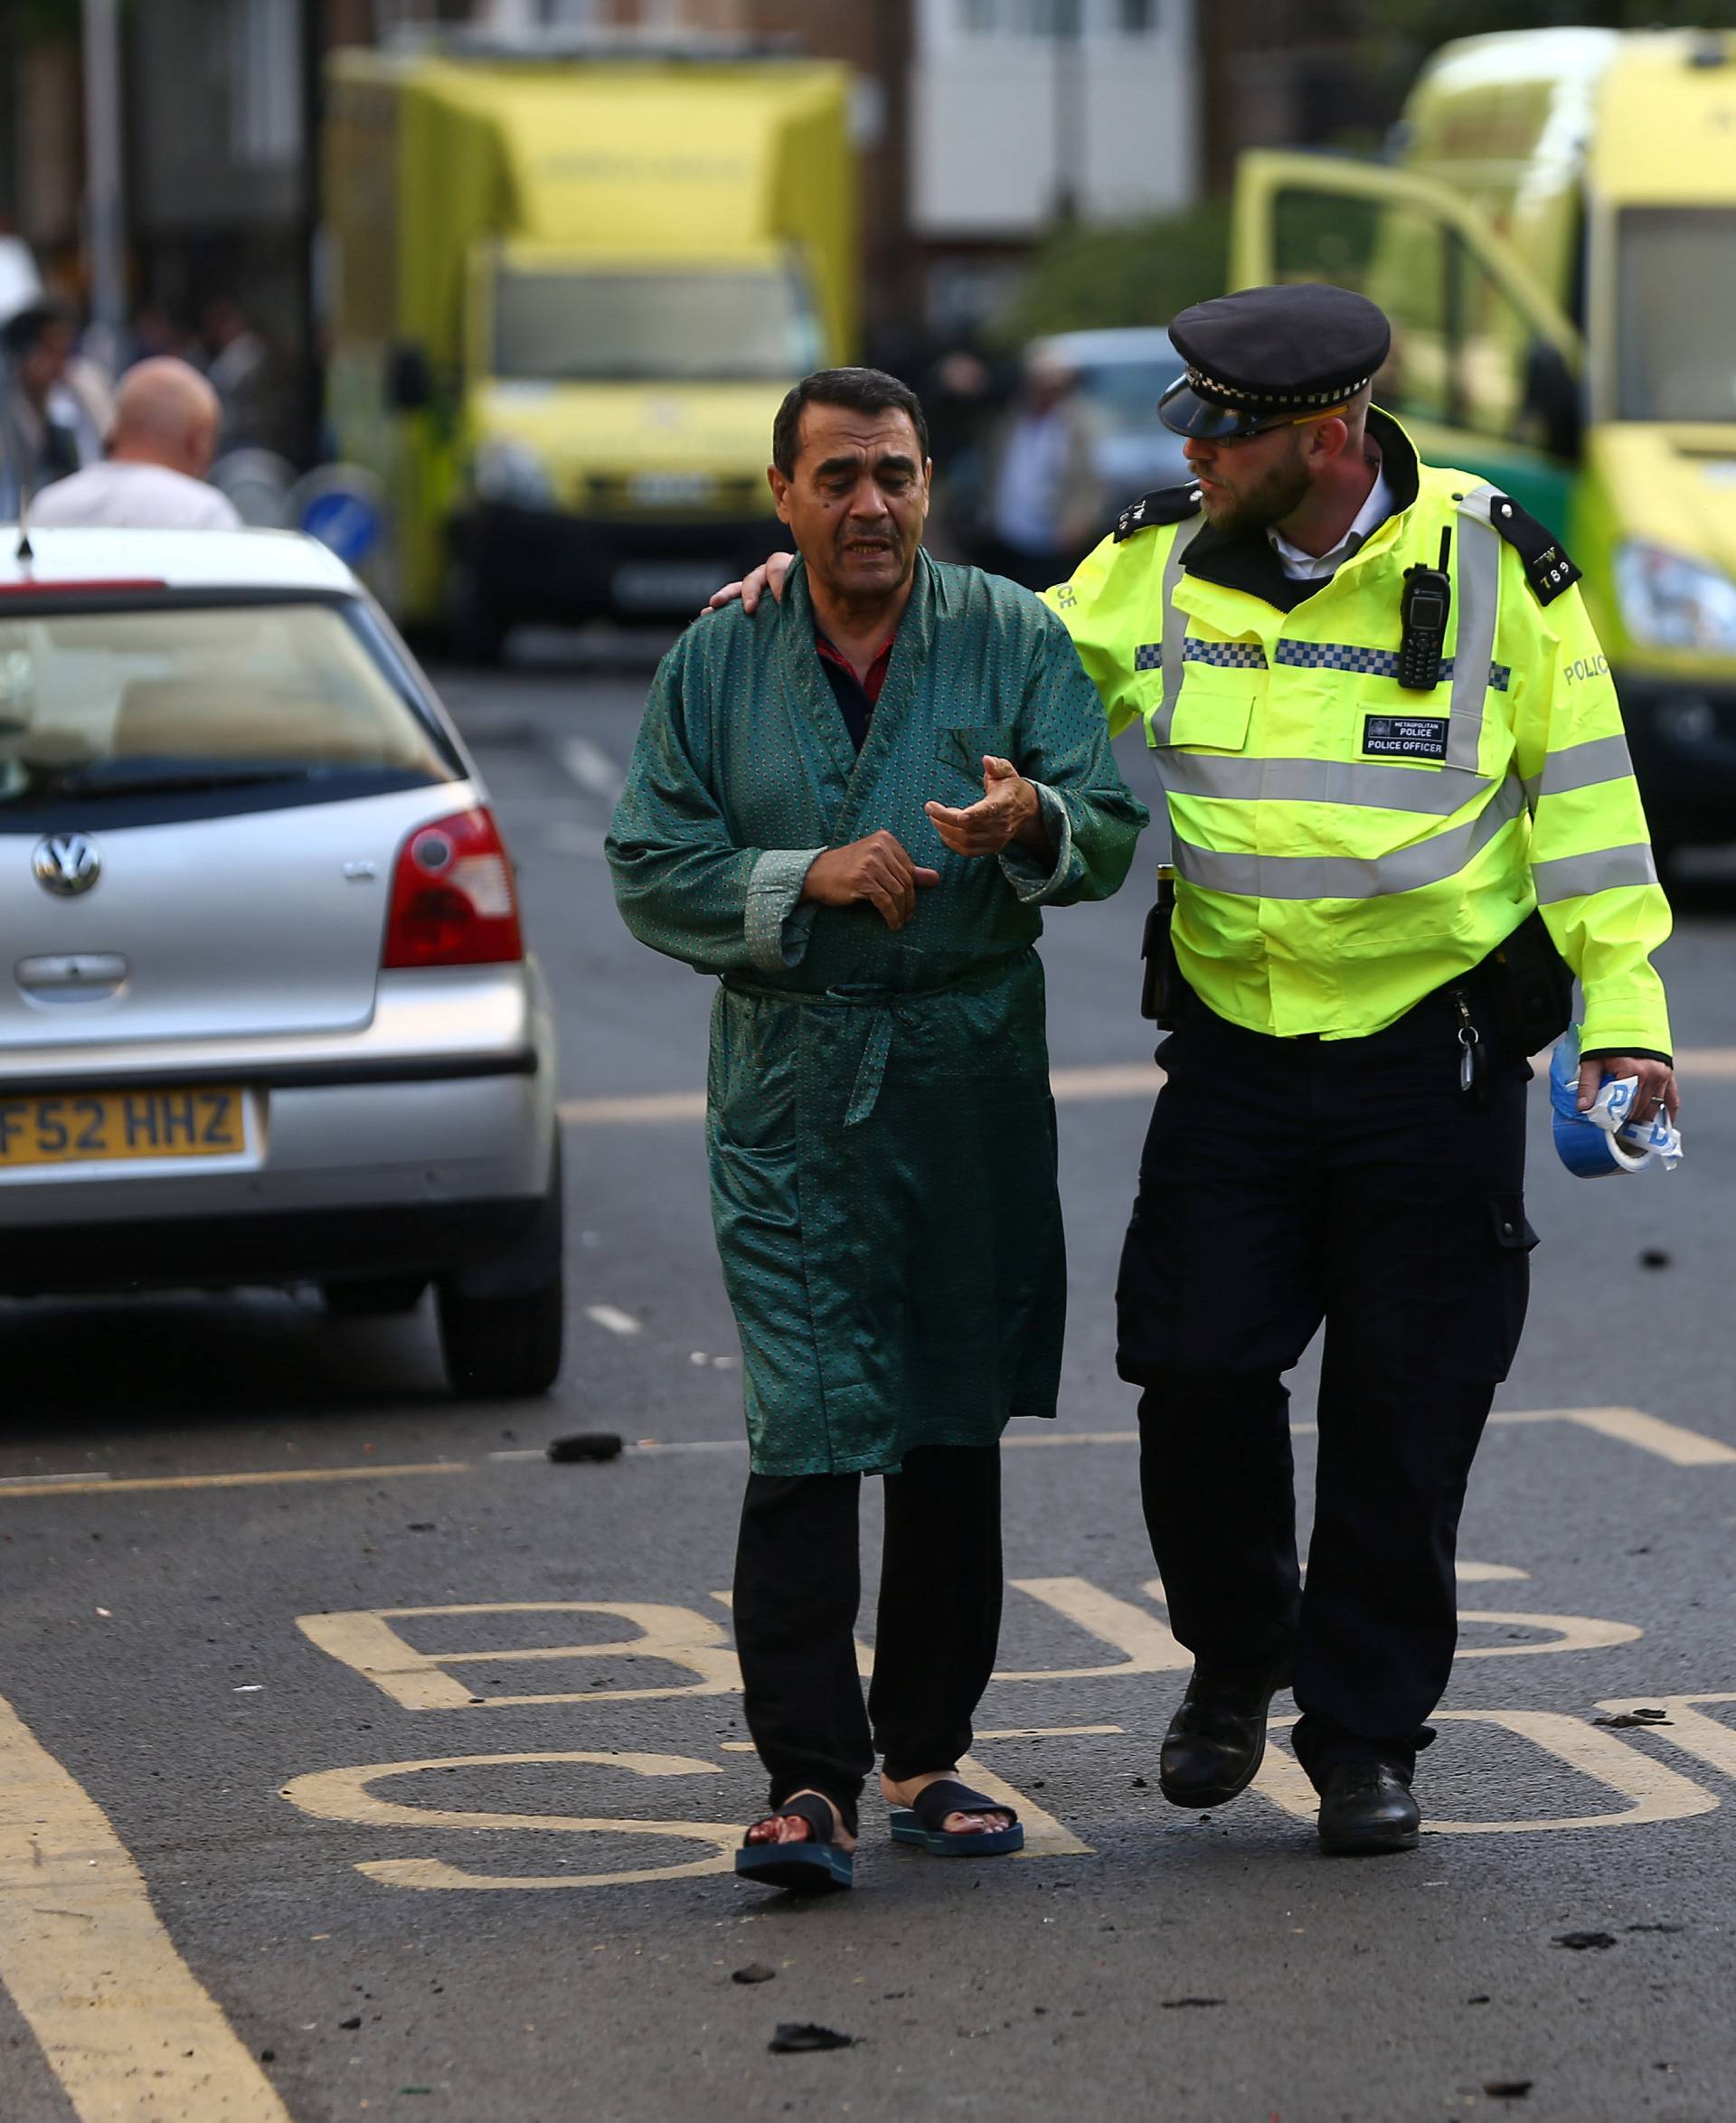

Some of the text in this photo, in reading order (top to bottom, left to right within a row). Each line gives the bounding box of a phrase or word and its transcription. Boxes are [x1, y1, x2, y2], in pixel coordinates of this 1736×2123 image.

[1540, 561, 1570, 590] 789
[1563, 654, 1609, 686] POLIC
[1368, 740, 1442, 753] POLICE OFFICER
[1400, 727, 1433, 737] POLICE
[0, 1091, 232, 1156] F52 HHZ
